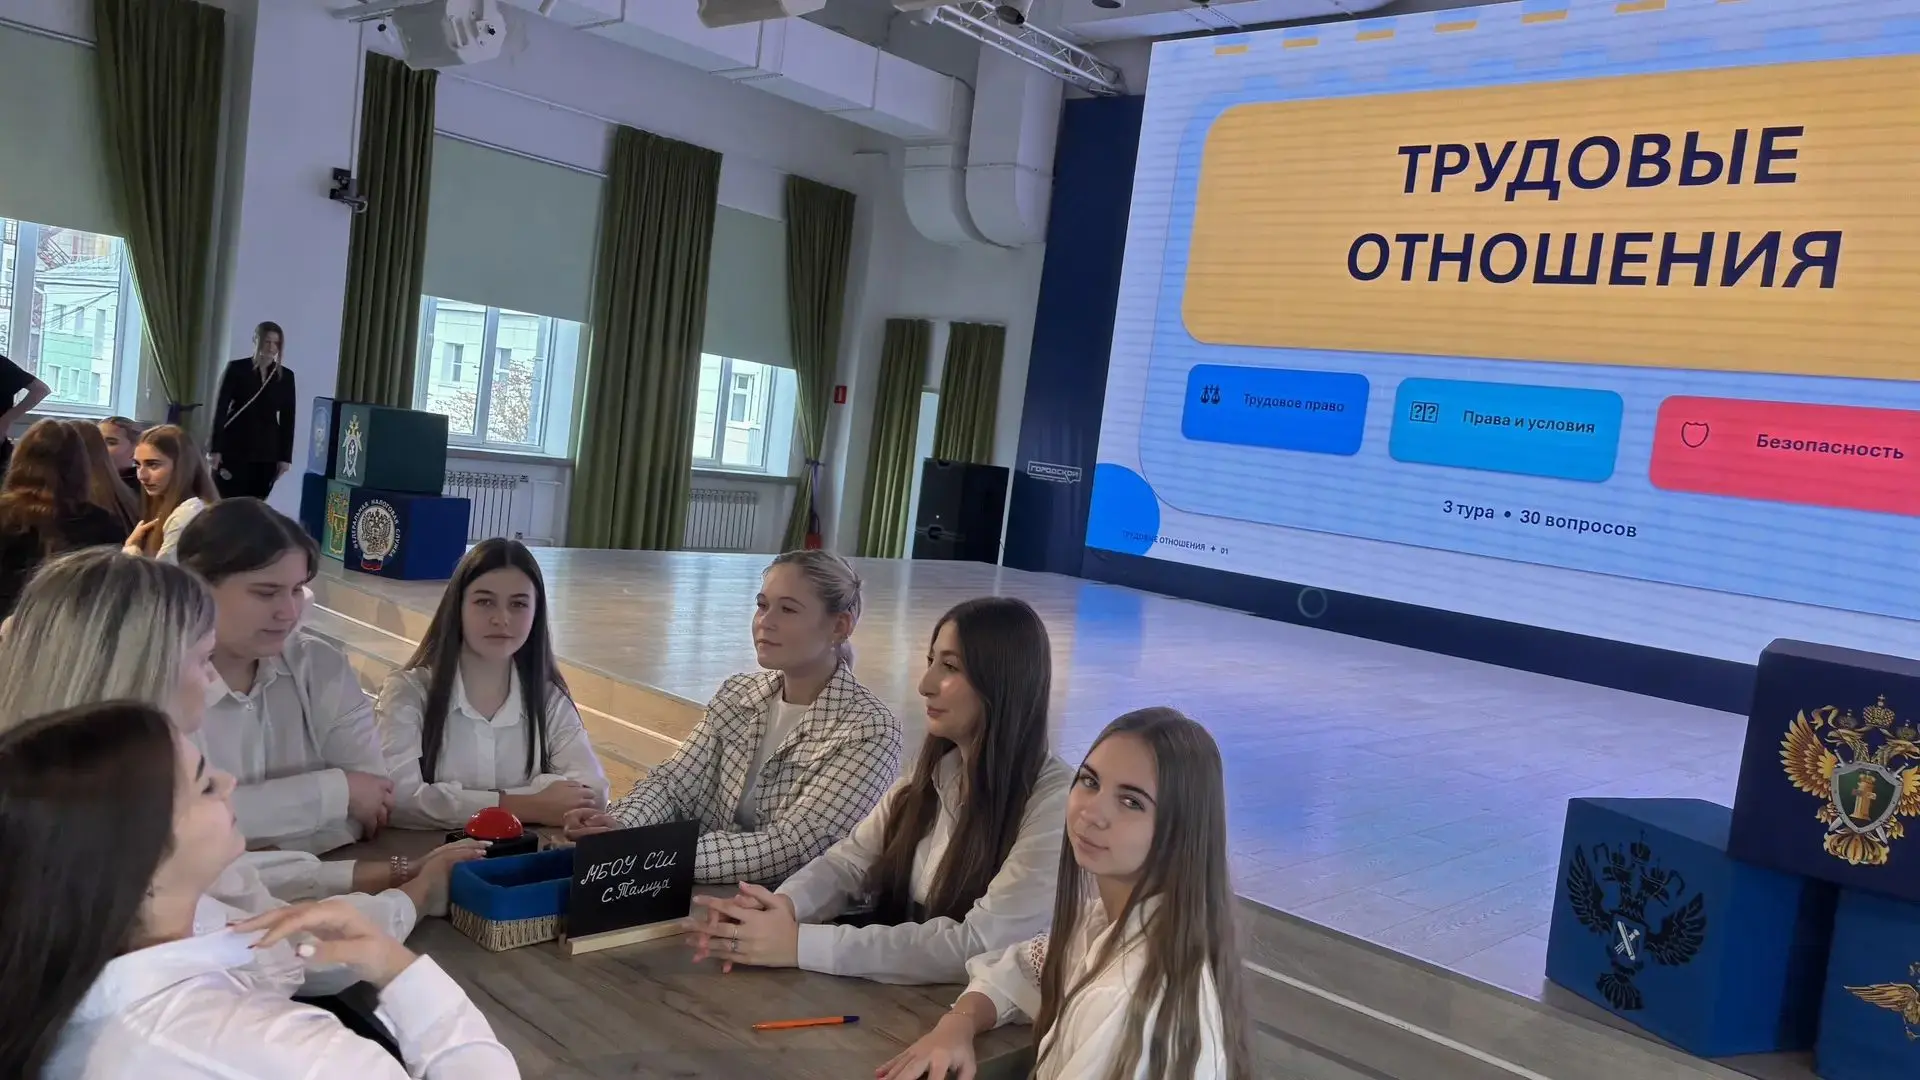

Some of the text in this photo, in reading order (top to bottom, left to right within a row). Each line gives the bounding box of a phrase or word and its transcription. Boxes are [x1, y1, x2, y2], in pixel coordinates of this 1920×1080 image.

[1397, 125, 1804, 202] ТРУДОВЫЕ
[1347, 229, 1843, 289] ОТНОШЕНИЯ
[1243, 393, 1345, 412] Трудовое право
[1463, 410, 1596, 434] Права и условия
[1756, 433, 1905, 460] Безопасность
[1443, 500, 1637, 538] 3 тура 30 вопросов
[1159, 536, 1206, 552] ОТНОШЕНИЯ
[1220, 547, 1229, 555] 01
[580, 854, 638, 885] МБОУ
